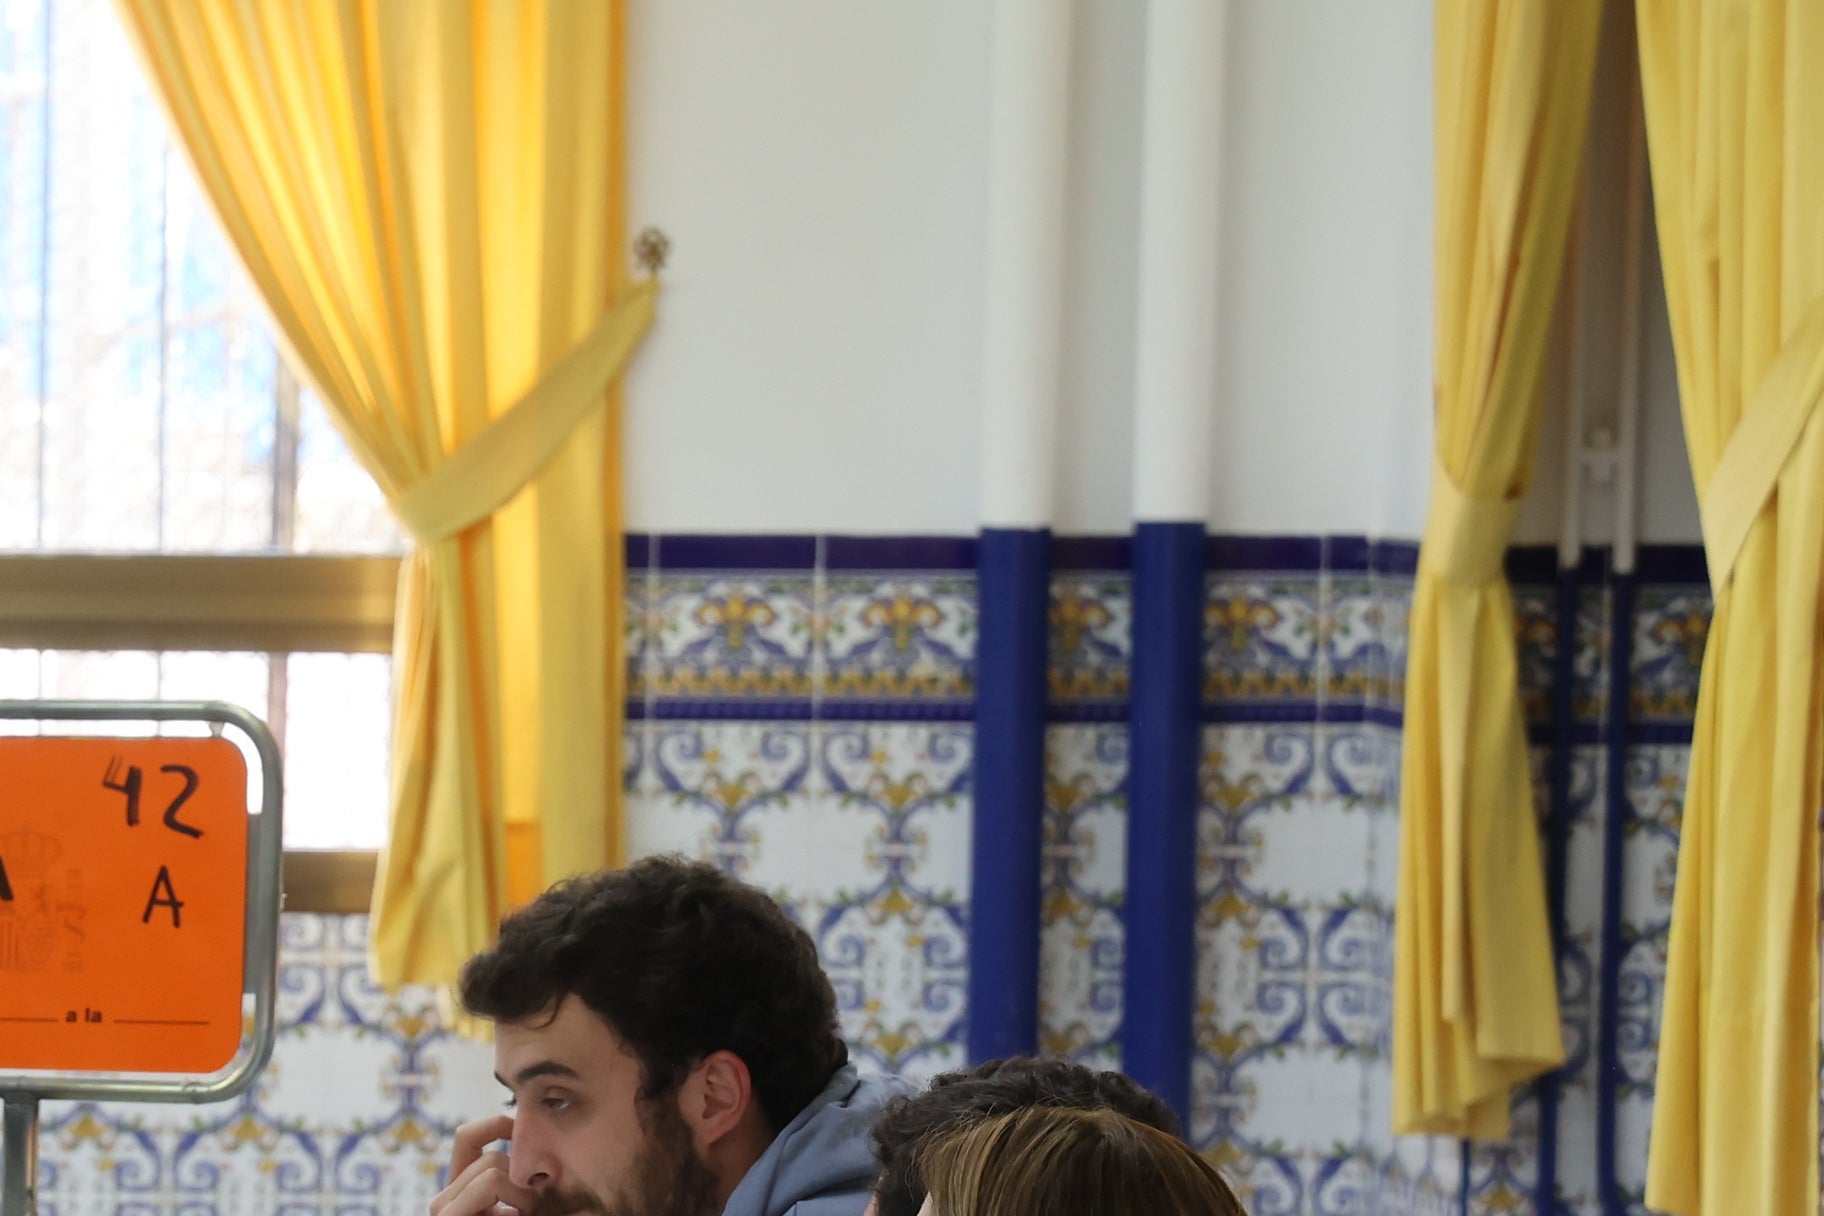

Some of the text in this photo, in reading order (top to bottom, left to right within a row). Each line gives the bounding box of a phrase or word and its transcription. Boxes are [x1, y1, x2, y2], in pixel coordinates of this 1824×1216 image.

[102, 754, 205, 839] 42
[141, 864, 185, 929] A
[65, 1010, 78, 1024] a
[84, 1007, 103, 1024] la
